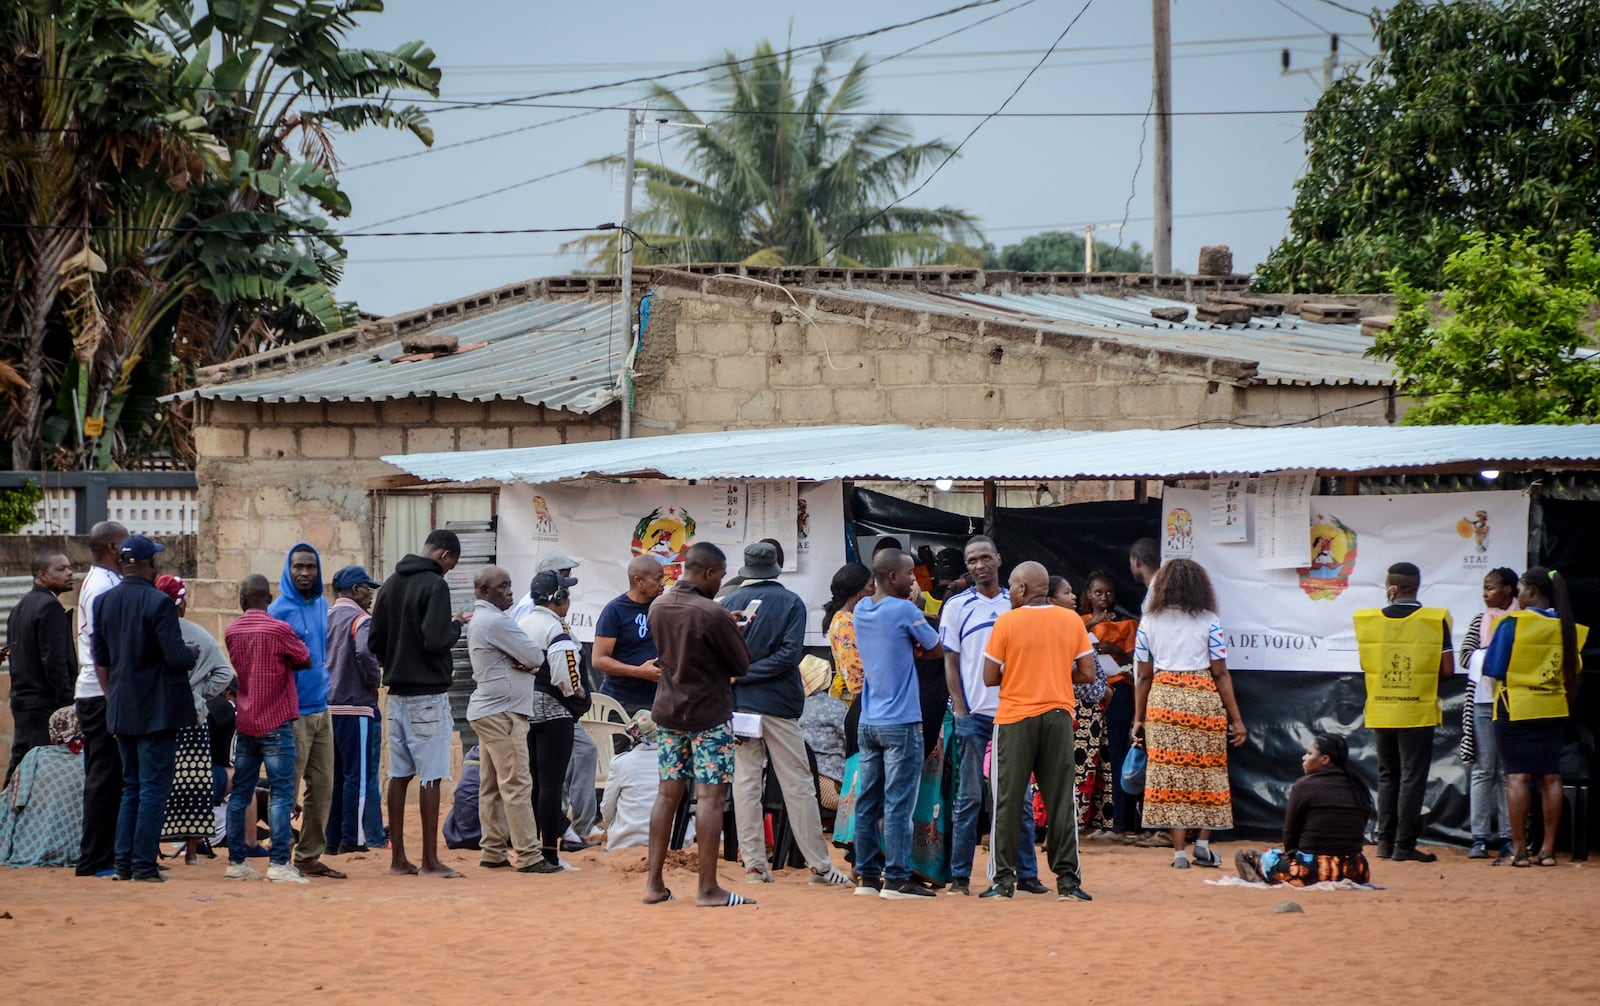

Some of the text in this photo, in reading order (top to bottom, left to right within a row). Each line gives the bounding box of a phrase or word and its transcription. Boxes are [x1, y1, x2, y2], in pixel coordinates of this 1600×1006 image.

[1463, 555, 1489, 564] STAE
[566, 612, 593, 627] EIA
[1240, 634, 1259, 648] DE
[1263, 634, 1304, 649] VOTO
